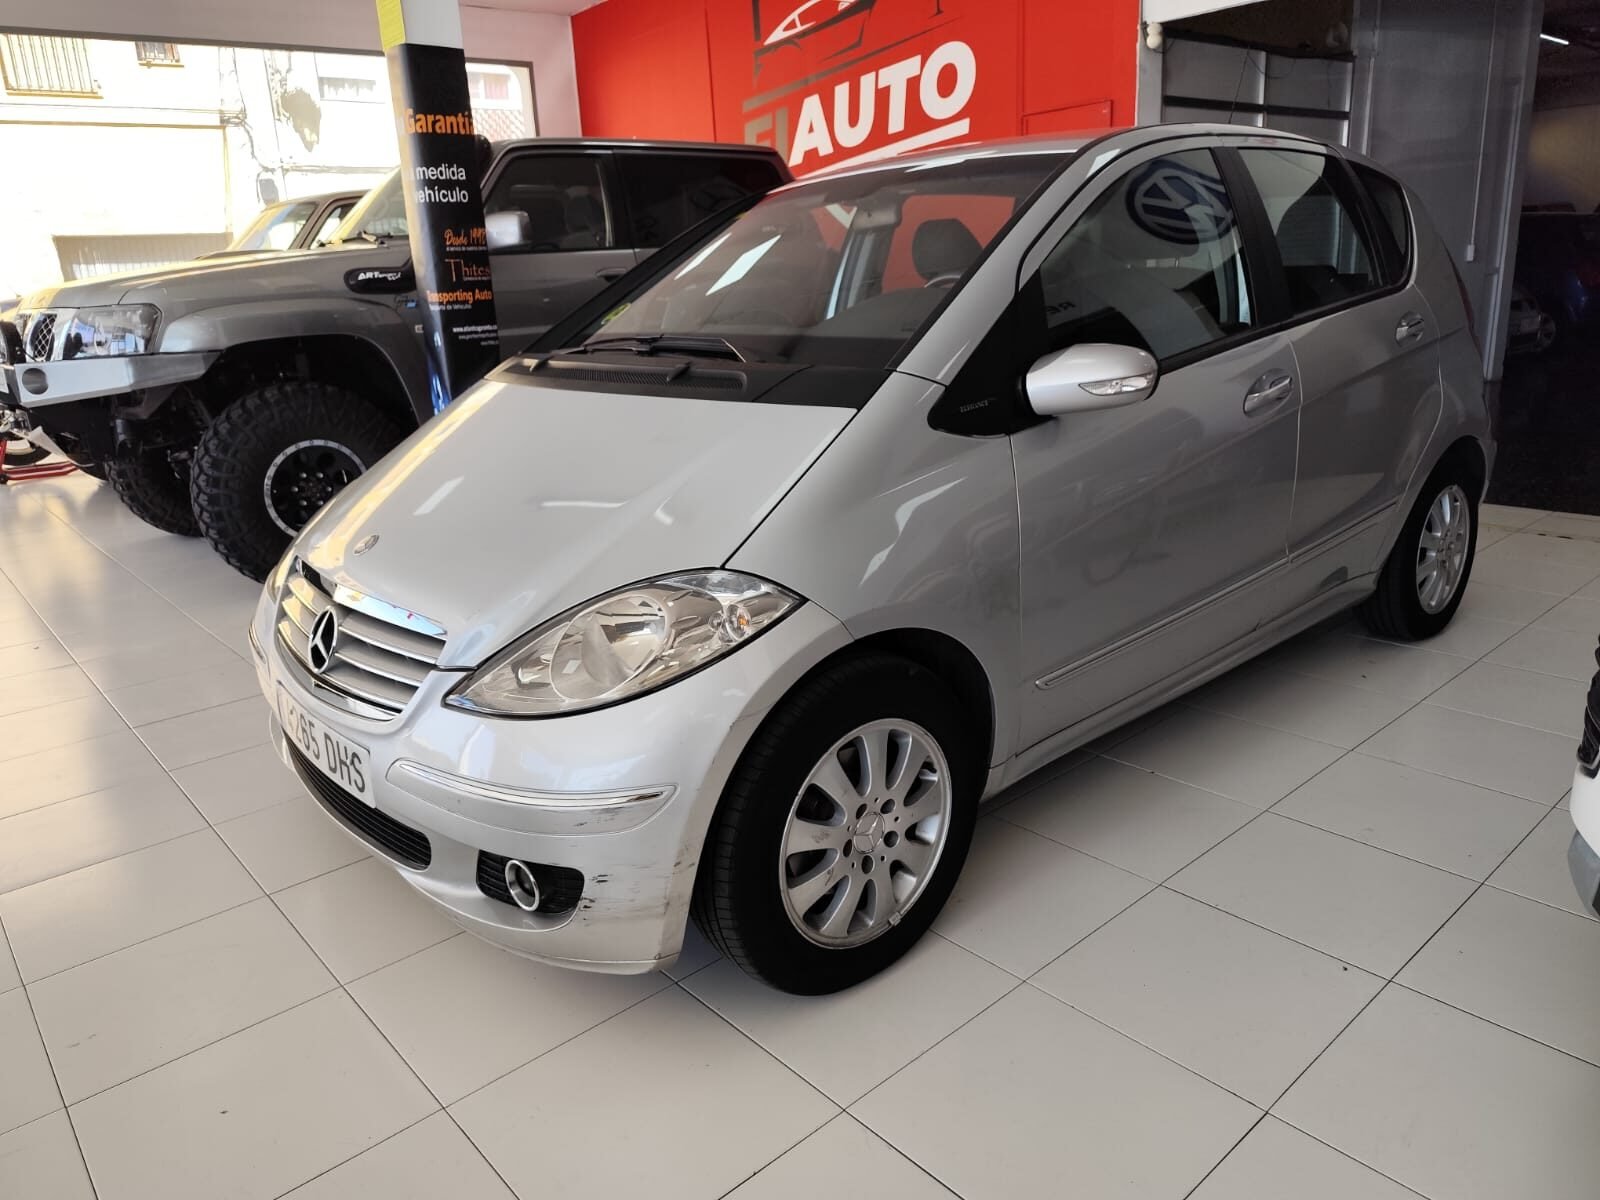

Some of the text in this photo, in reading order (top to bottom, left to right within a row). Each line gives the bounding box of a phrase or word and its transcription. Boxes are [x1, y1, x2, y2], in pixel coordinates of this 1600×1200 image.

[415, 163, 466, 181] medida
[474, 287, 493, 302] Auto
[323, 731, 367, 794] DHS
